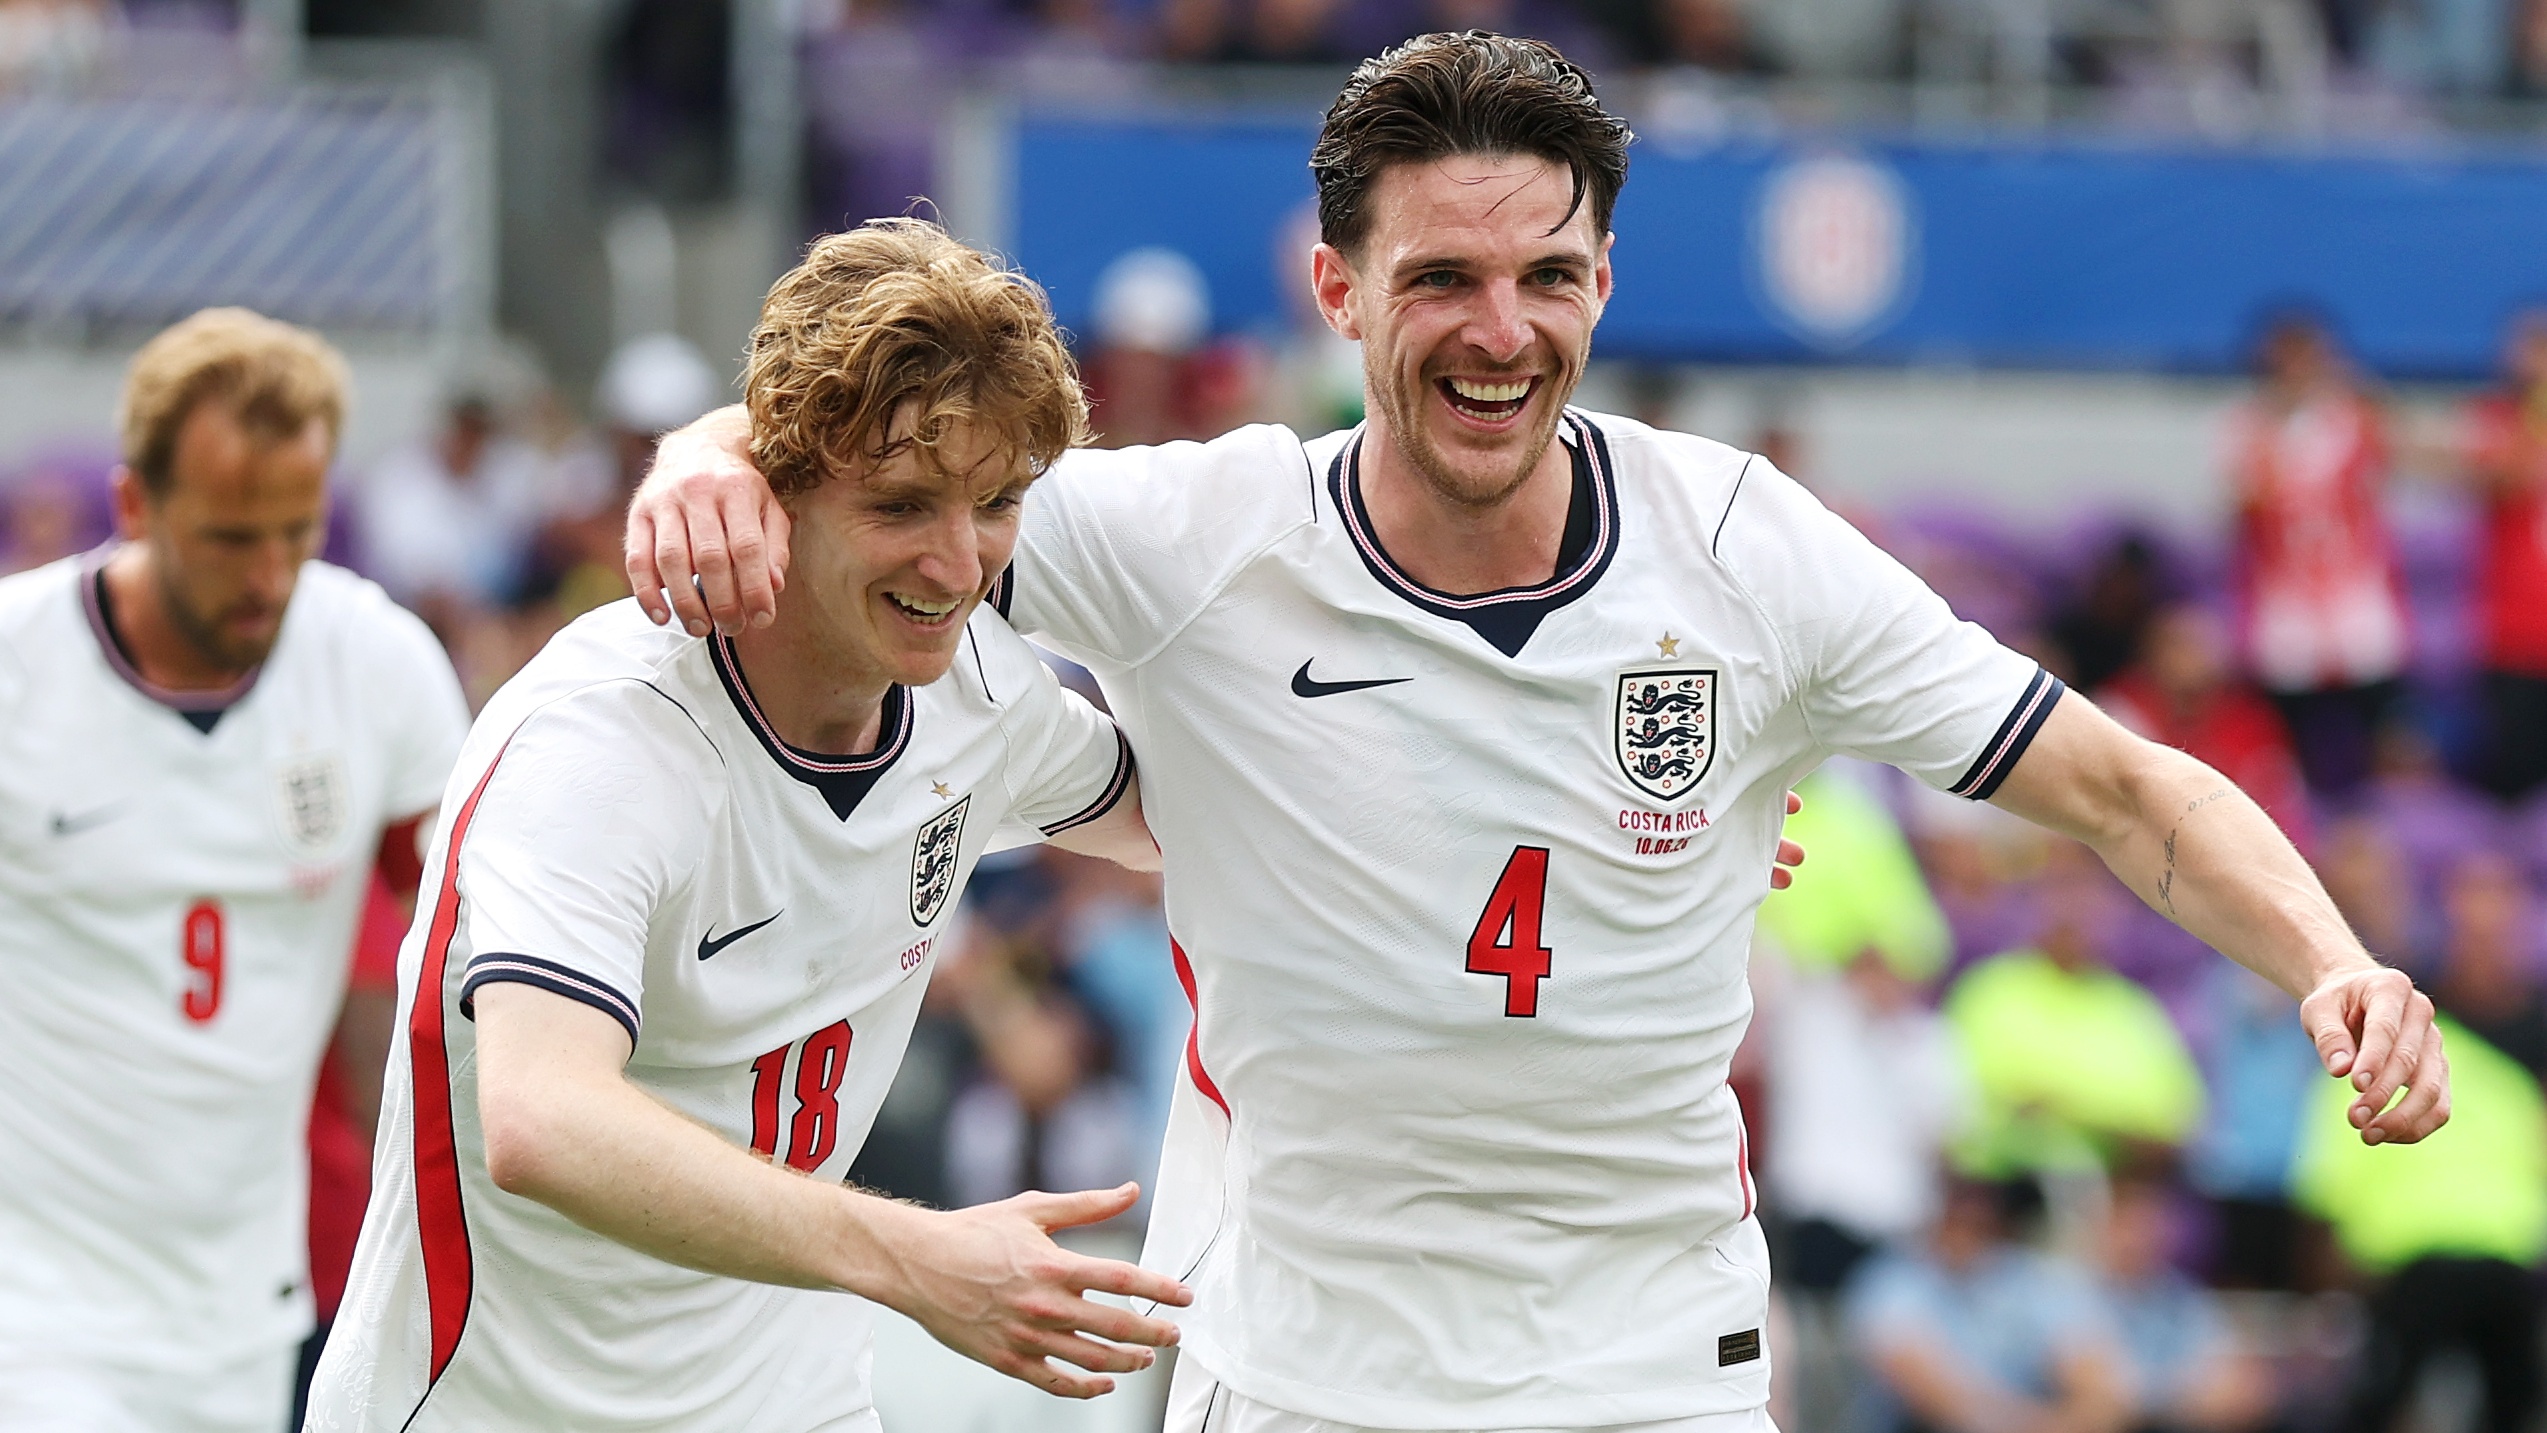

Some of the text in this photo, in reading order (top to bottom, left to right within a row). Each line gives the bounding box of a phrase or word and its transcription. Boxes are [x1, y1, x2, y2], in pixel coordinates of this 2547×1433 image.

[1619, 809, 1710, 832] COSTA RICA
[182, 900, 224, 1024] 9
[1465, 844, 1552, 1018] 4
[750, 1018, 853, 1174] 18
